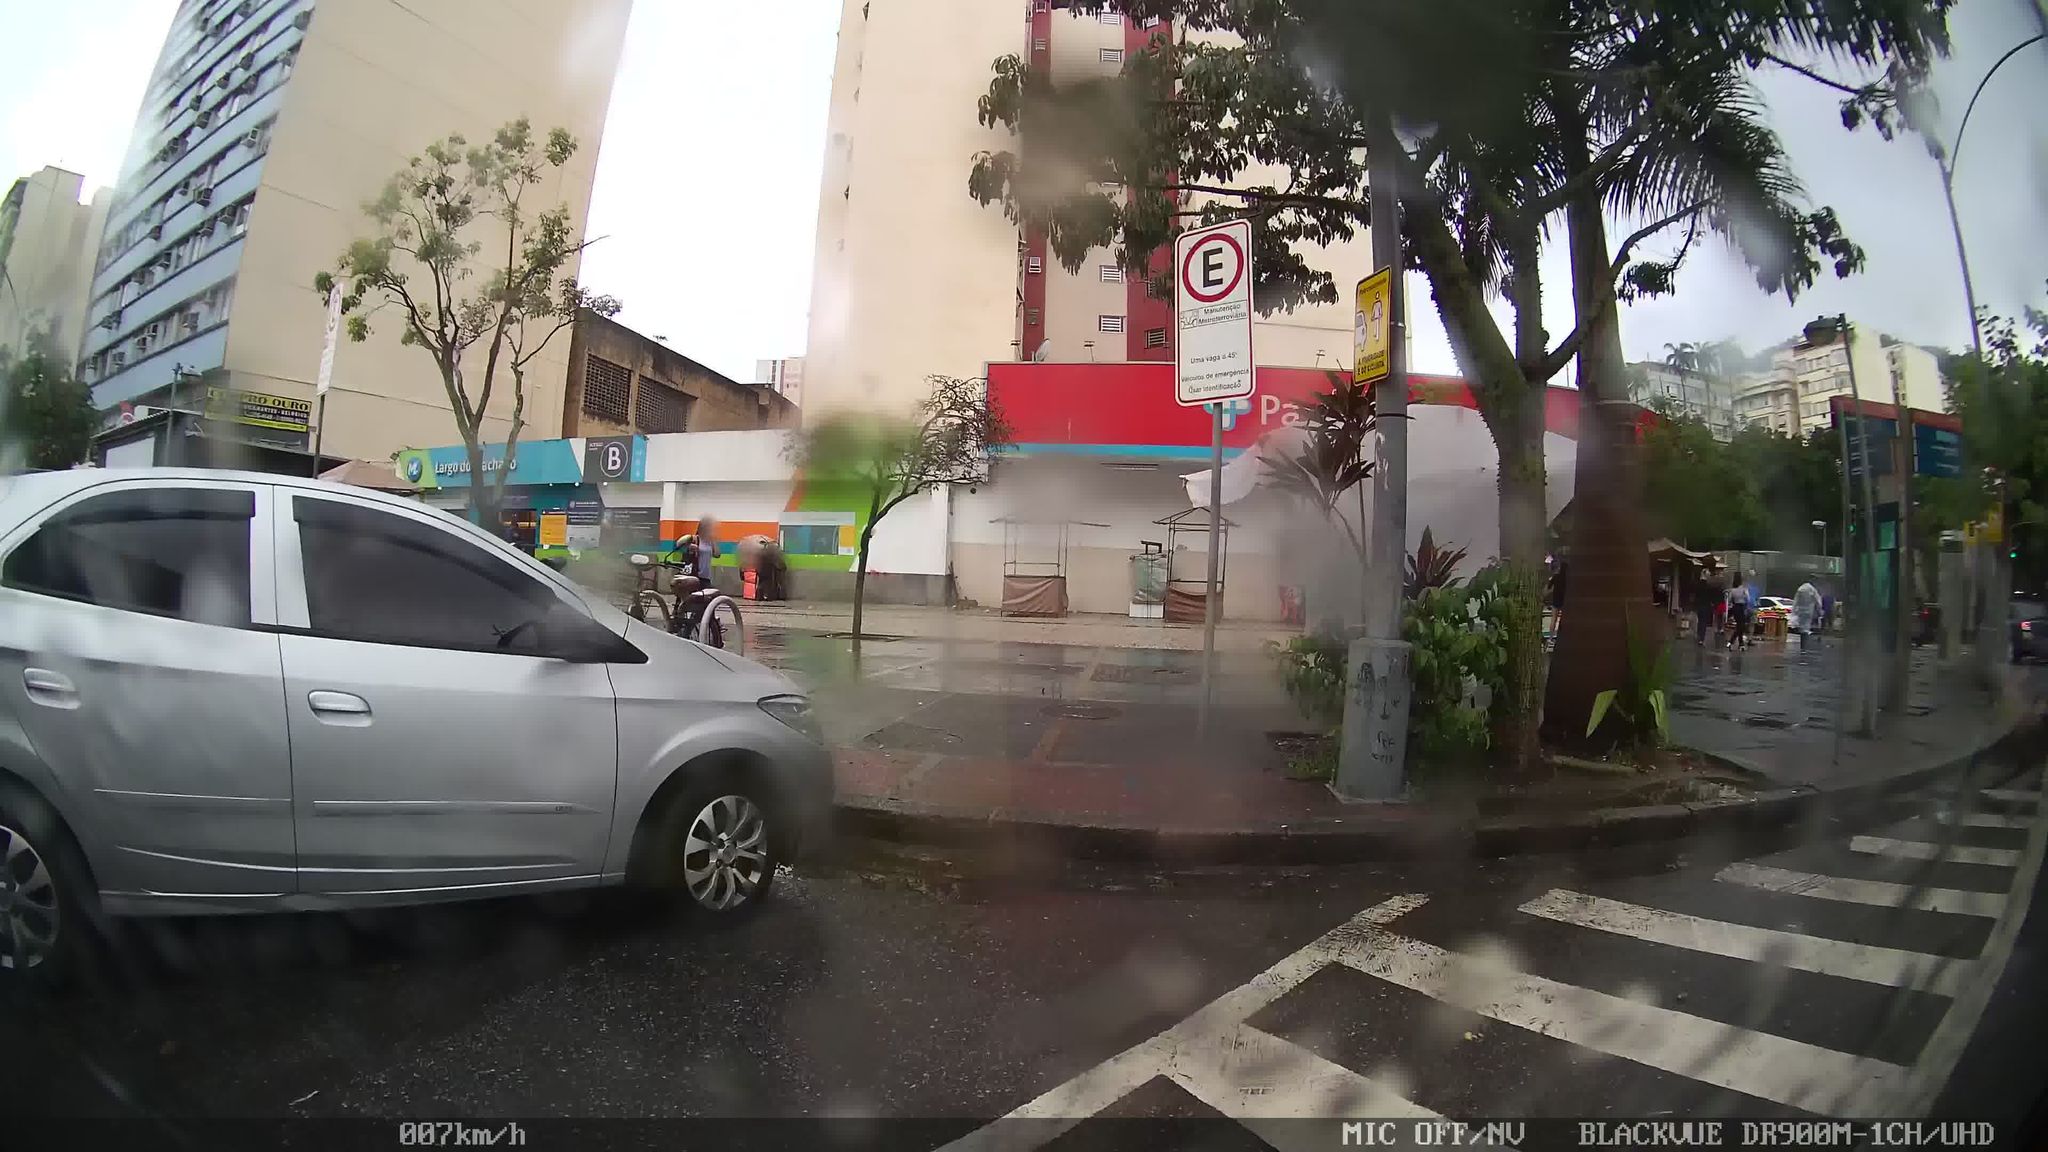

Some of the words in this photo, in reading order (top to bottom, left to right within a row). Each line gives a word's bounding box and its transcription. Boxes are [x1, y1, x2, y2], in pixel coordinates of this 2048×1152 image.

[1203, 247, 1223, 288] E
[272, 398, 309, 411] OURO
[435, 461, 458, 476] Largo
[459, 458, 471, 471] do
[608, 446, 621, 470] B
